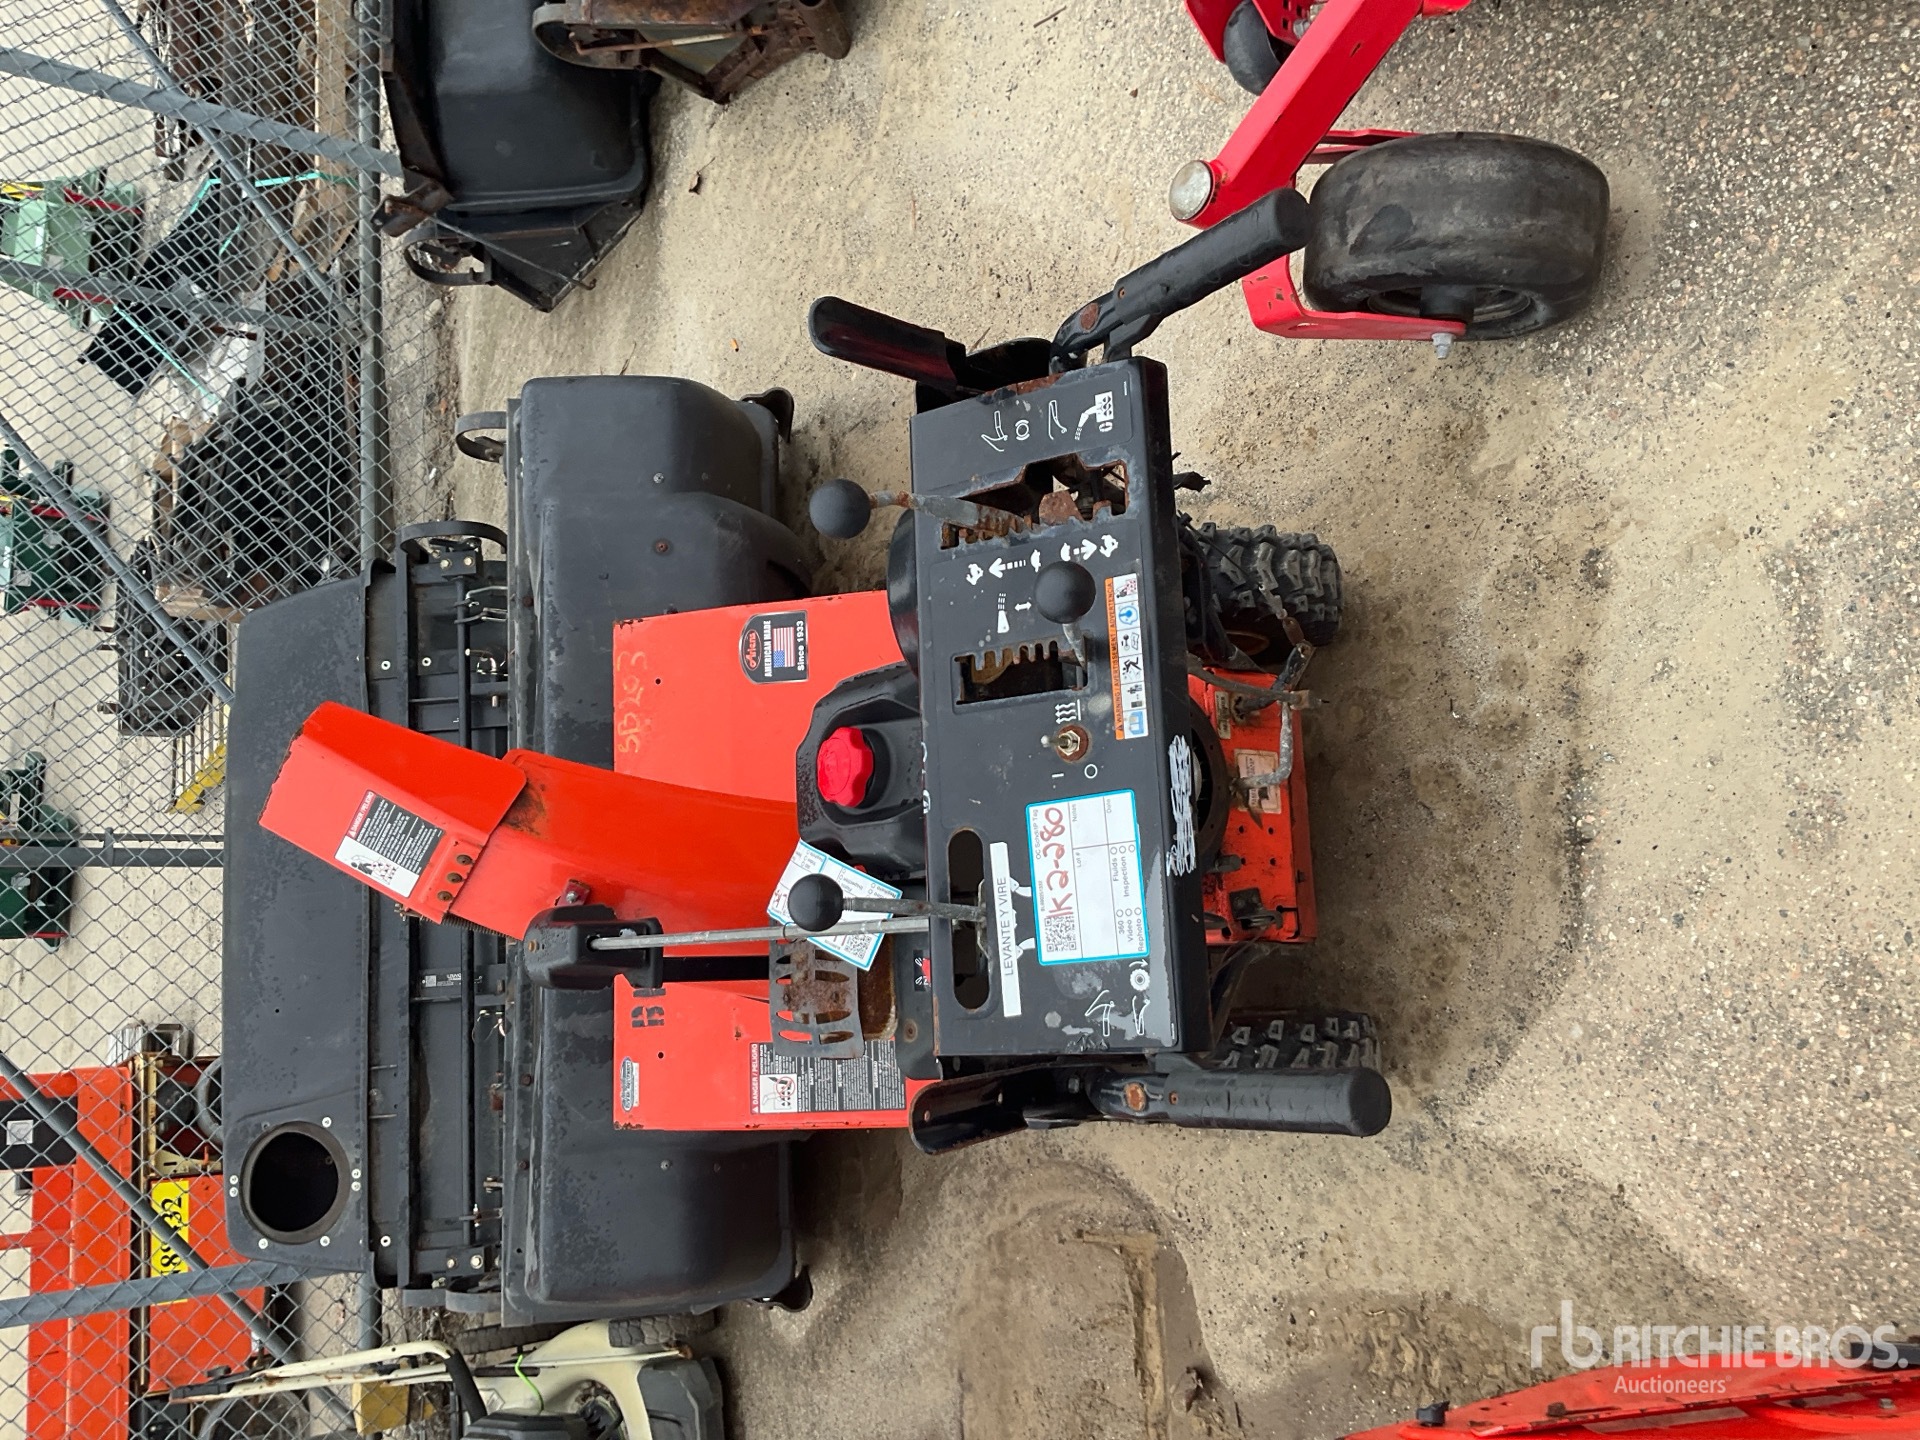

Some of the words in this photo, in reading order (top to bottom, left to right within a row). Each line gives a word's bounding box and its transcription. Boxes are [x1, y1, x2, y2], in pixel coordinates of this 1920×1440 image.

[1107, 582, 1115, 628] ADVERTENCIA
[763, 620, 771, 640] MADE
[796, 620, 804, 642] 1933
[746, 632, 756, 668] Ariens
[764, 641, 772, 677] AMERICAN
[1110, 634, 1119, 687] AVERTISSEMENT
[997, 876, 1007, 906] VIRE
[1121, 856, 1130, 897] Inspection
[1000, 909, 1009, 918] Y
[1000, 920, 1014, 976] LEVANTE
